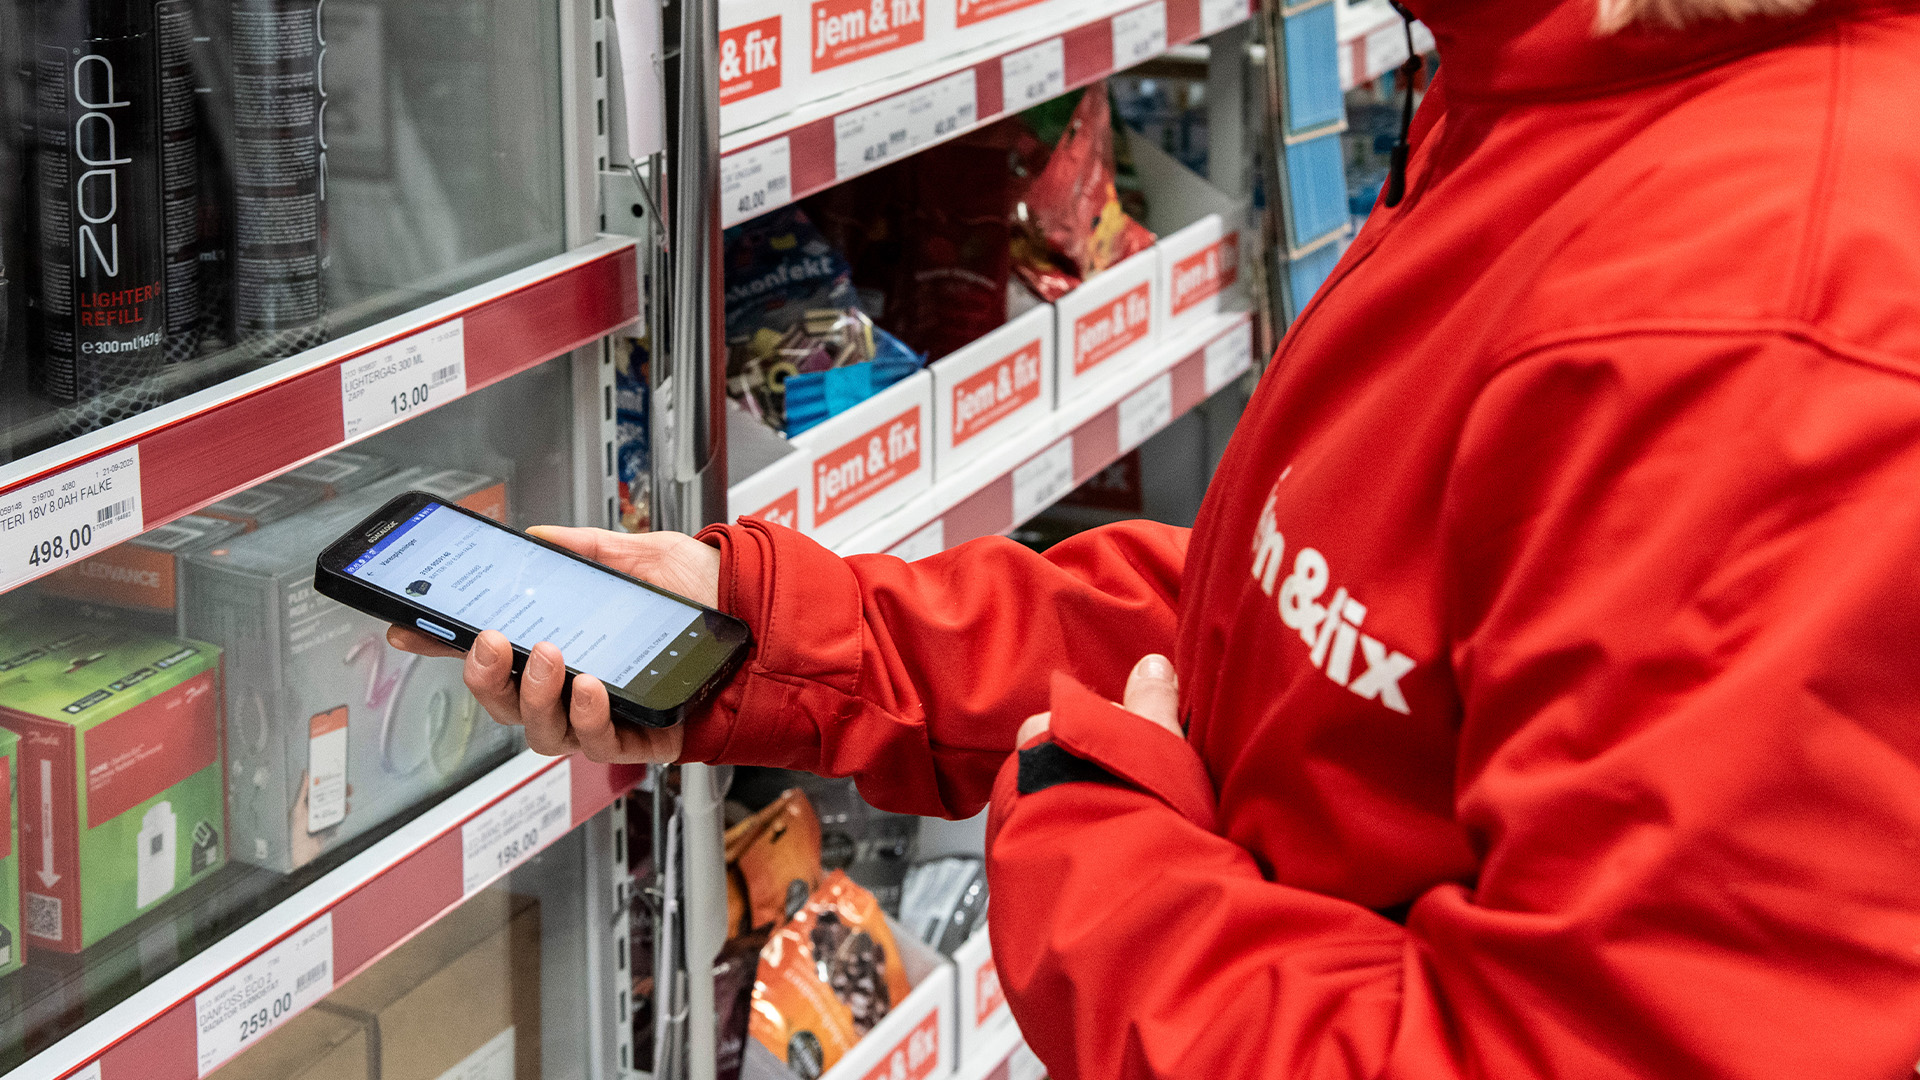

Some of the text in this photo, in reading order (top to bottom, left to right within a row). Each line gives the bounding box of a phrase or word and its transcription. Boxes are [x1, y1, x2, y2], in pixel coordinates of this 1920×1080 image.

[815, 8, 866, 59] jem
[868, 0, 889, 34] &
[719, 29, 777, 81] & fix
[74, 54, 131, 279] zapp
[81, 284, 153, 308] LIGHTER
[82, 307, 144, 327] REFILL
[345, 363, 397, 393] LIGHTERGAS
[398, 357, 411, 371] 300
[391, 383, 428, 414] 13,00
[955, 382, 995, 433] jem
[997, 364, 1013, 400] &
[1014, 352, 1037, 390] fix
[32, 489, 54, 504] S19700
[61, 480, 76, 492] 4080
[102, 457, 134, 476] 21-09-2025
[817, 453, 864, 513] jem
[866, 435, 885, 475] &
[888, 421, 917, 464] fix
[28, 503, 47, 521] 18V
[49, 491, 78, 513] 8.0AH
[80, 477, 112, 500] FALKE
[29, 523, 92, 567] 498,00
[1278, 547, 1329, 651] &
[240, 991, 292, 1043] 259,00
